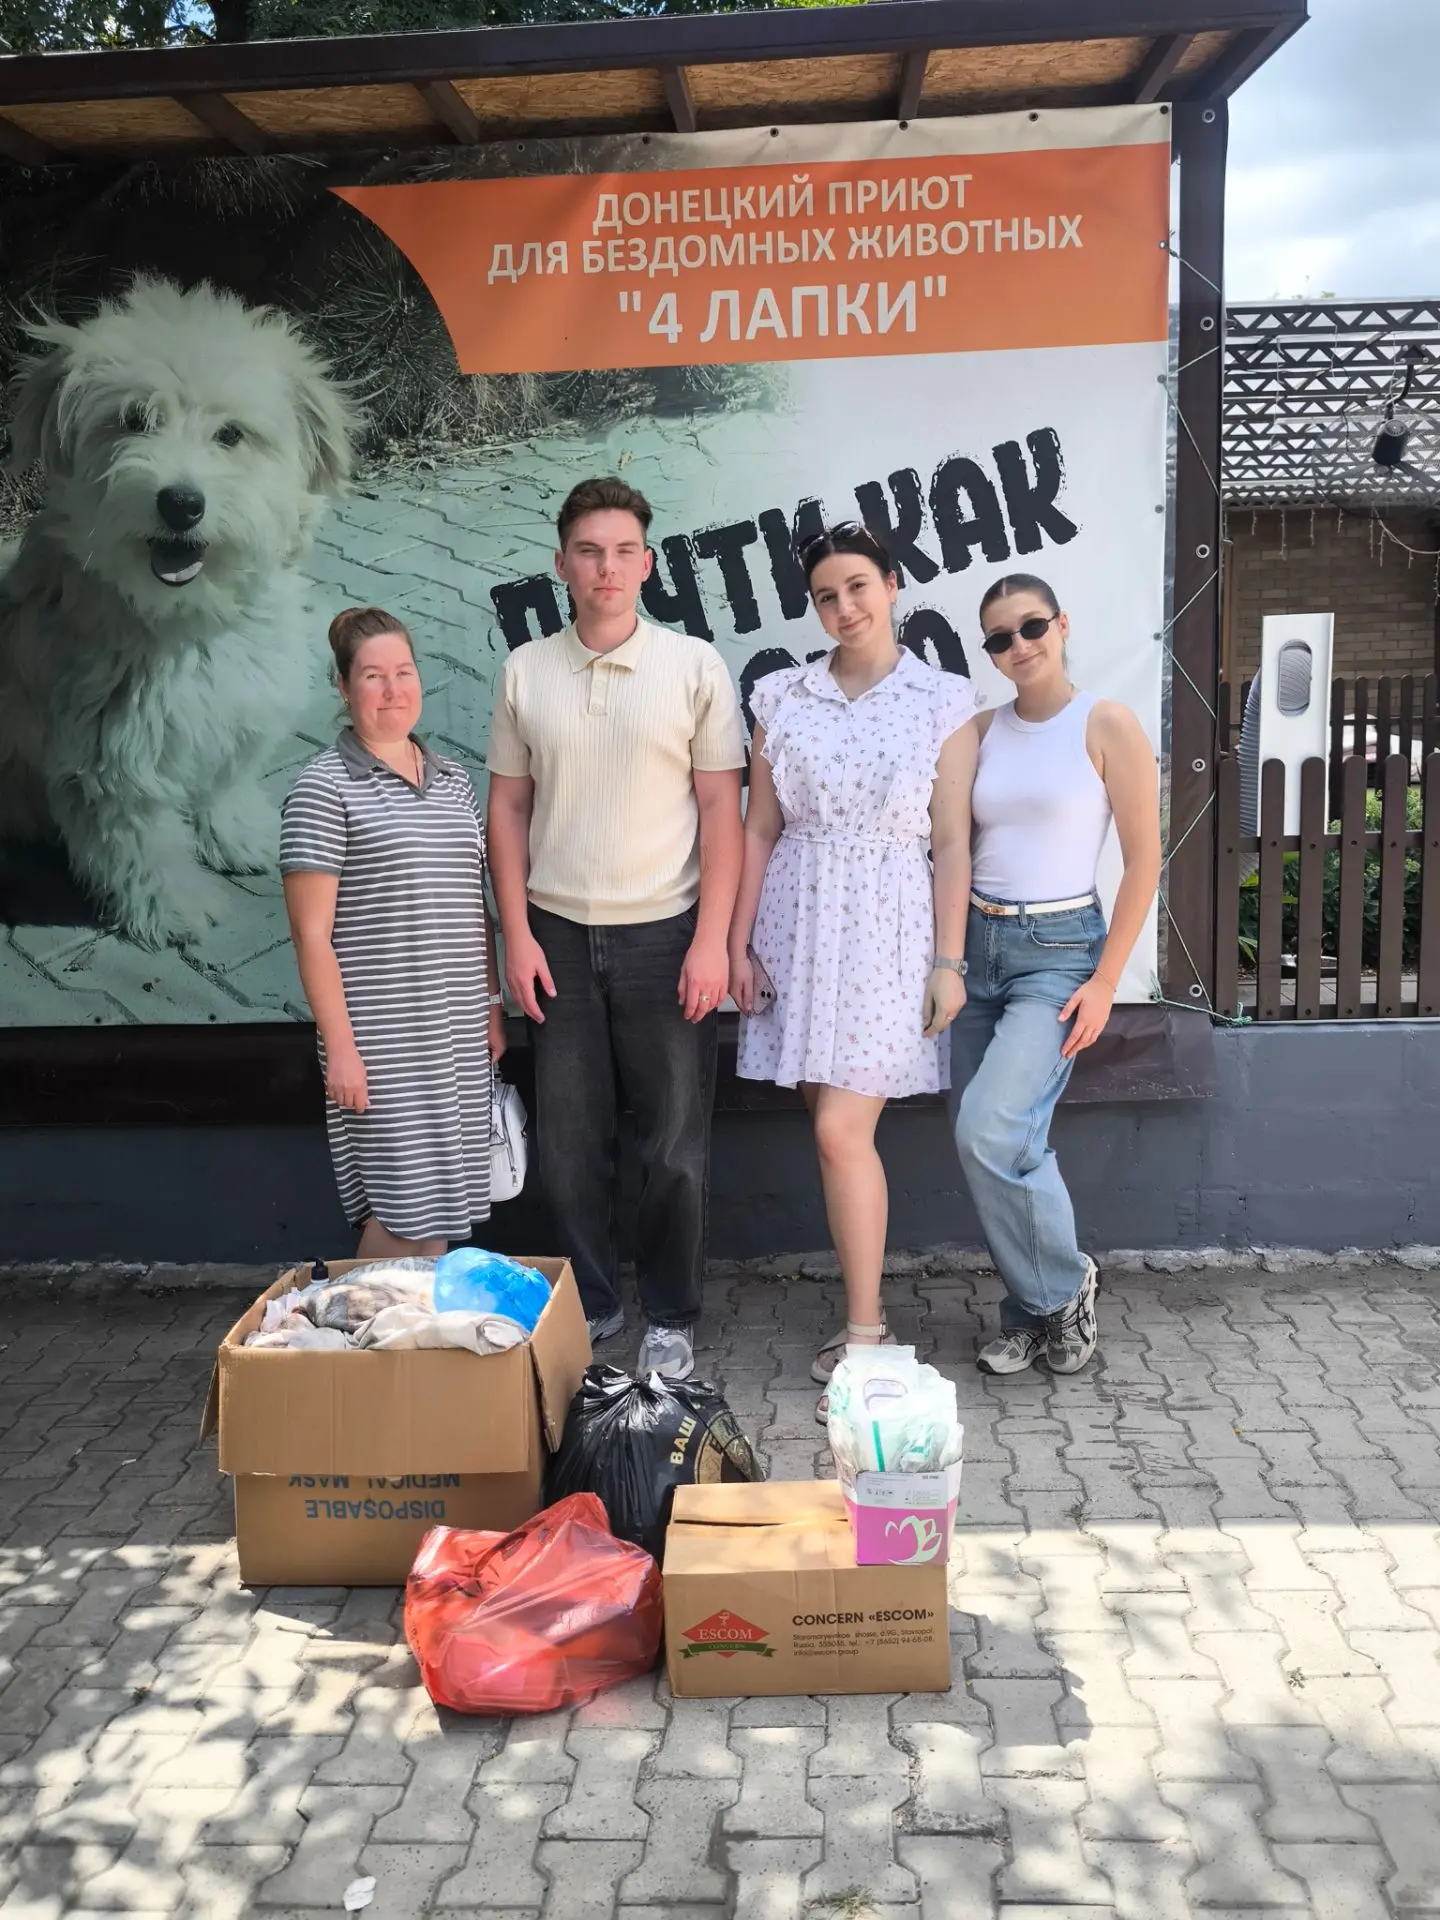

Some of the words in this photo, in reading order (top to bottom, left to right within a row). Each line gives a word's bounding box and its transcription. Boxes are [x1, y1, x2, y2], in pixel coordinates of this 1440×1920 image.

[592, 174, 814, 236] ДОНЕЦКИЙ
[828, 174, 973, 214] ПРИЮТ
[487, 241, 569, 284] ДЛЯ
[582, 228, 836, 277] БЕЗДОМНЫХ
[847, 214, 1084, 260] ЖИВОТНЫХ
[619, 290, 683, 343] "4
[700, 275, 947, 343] ЛАПКИ"
[489, 496, 826, 651] ПЧТИ
[854, 427, 1081, 589] КАК
[670, 1415, 697, 1465] ВАШ
[305, 1499, 446, 1520] DISPOSABLE
[698, 1628, 752, 1640] ESCOM
[792, 1612, 863, 1626] CONCERN
[868, 1609, 934, 1622] «ESCOM»
